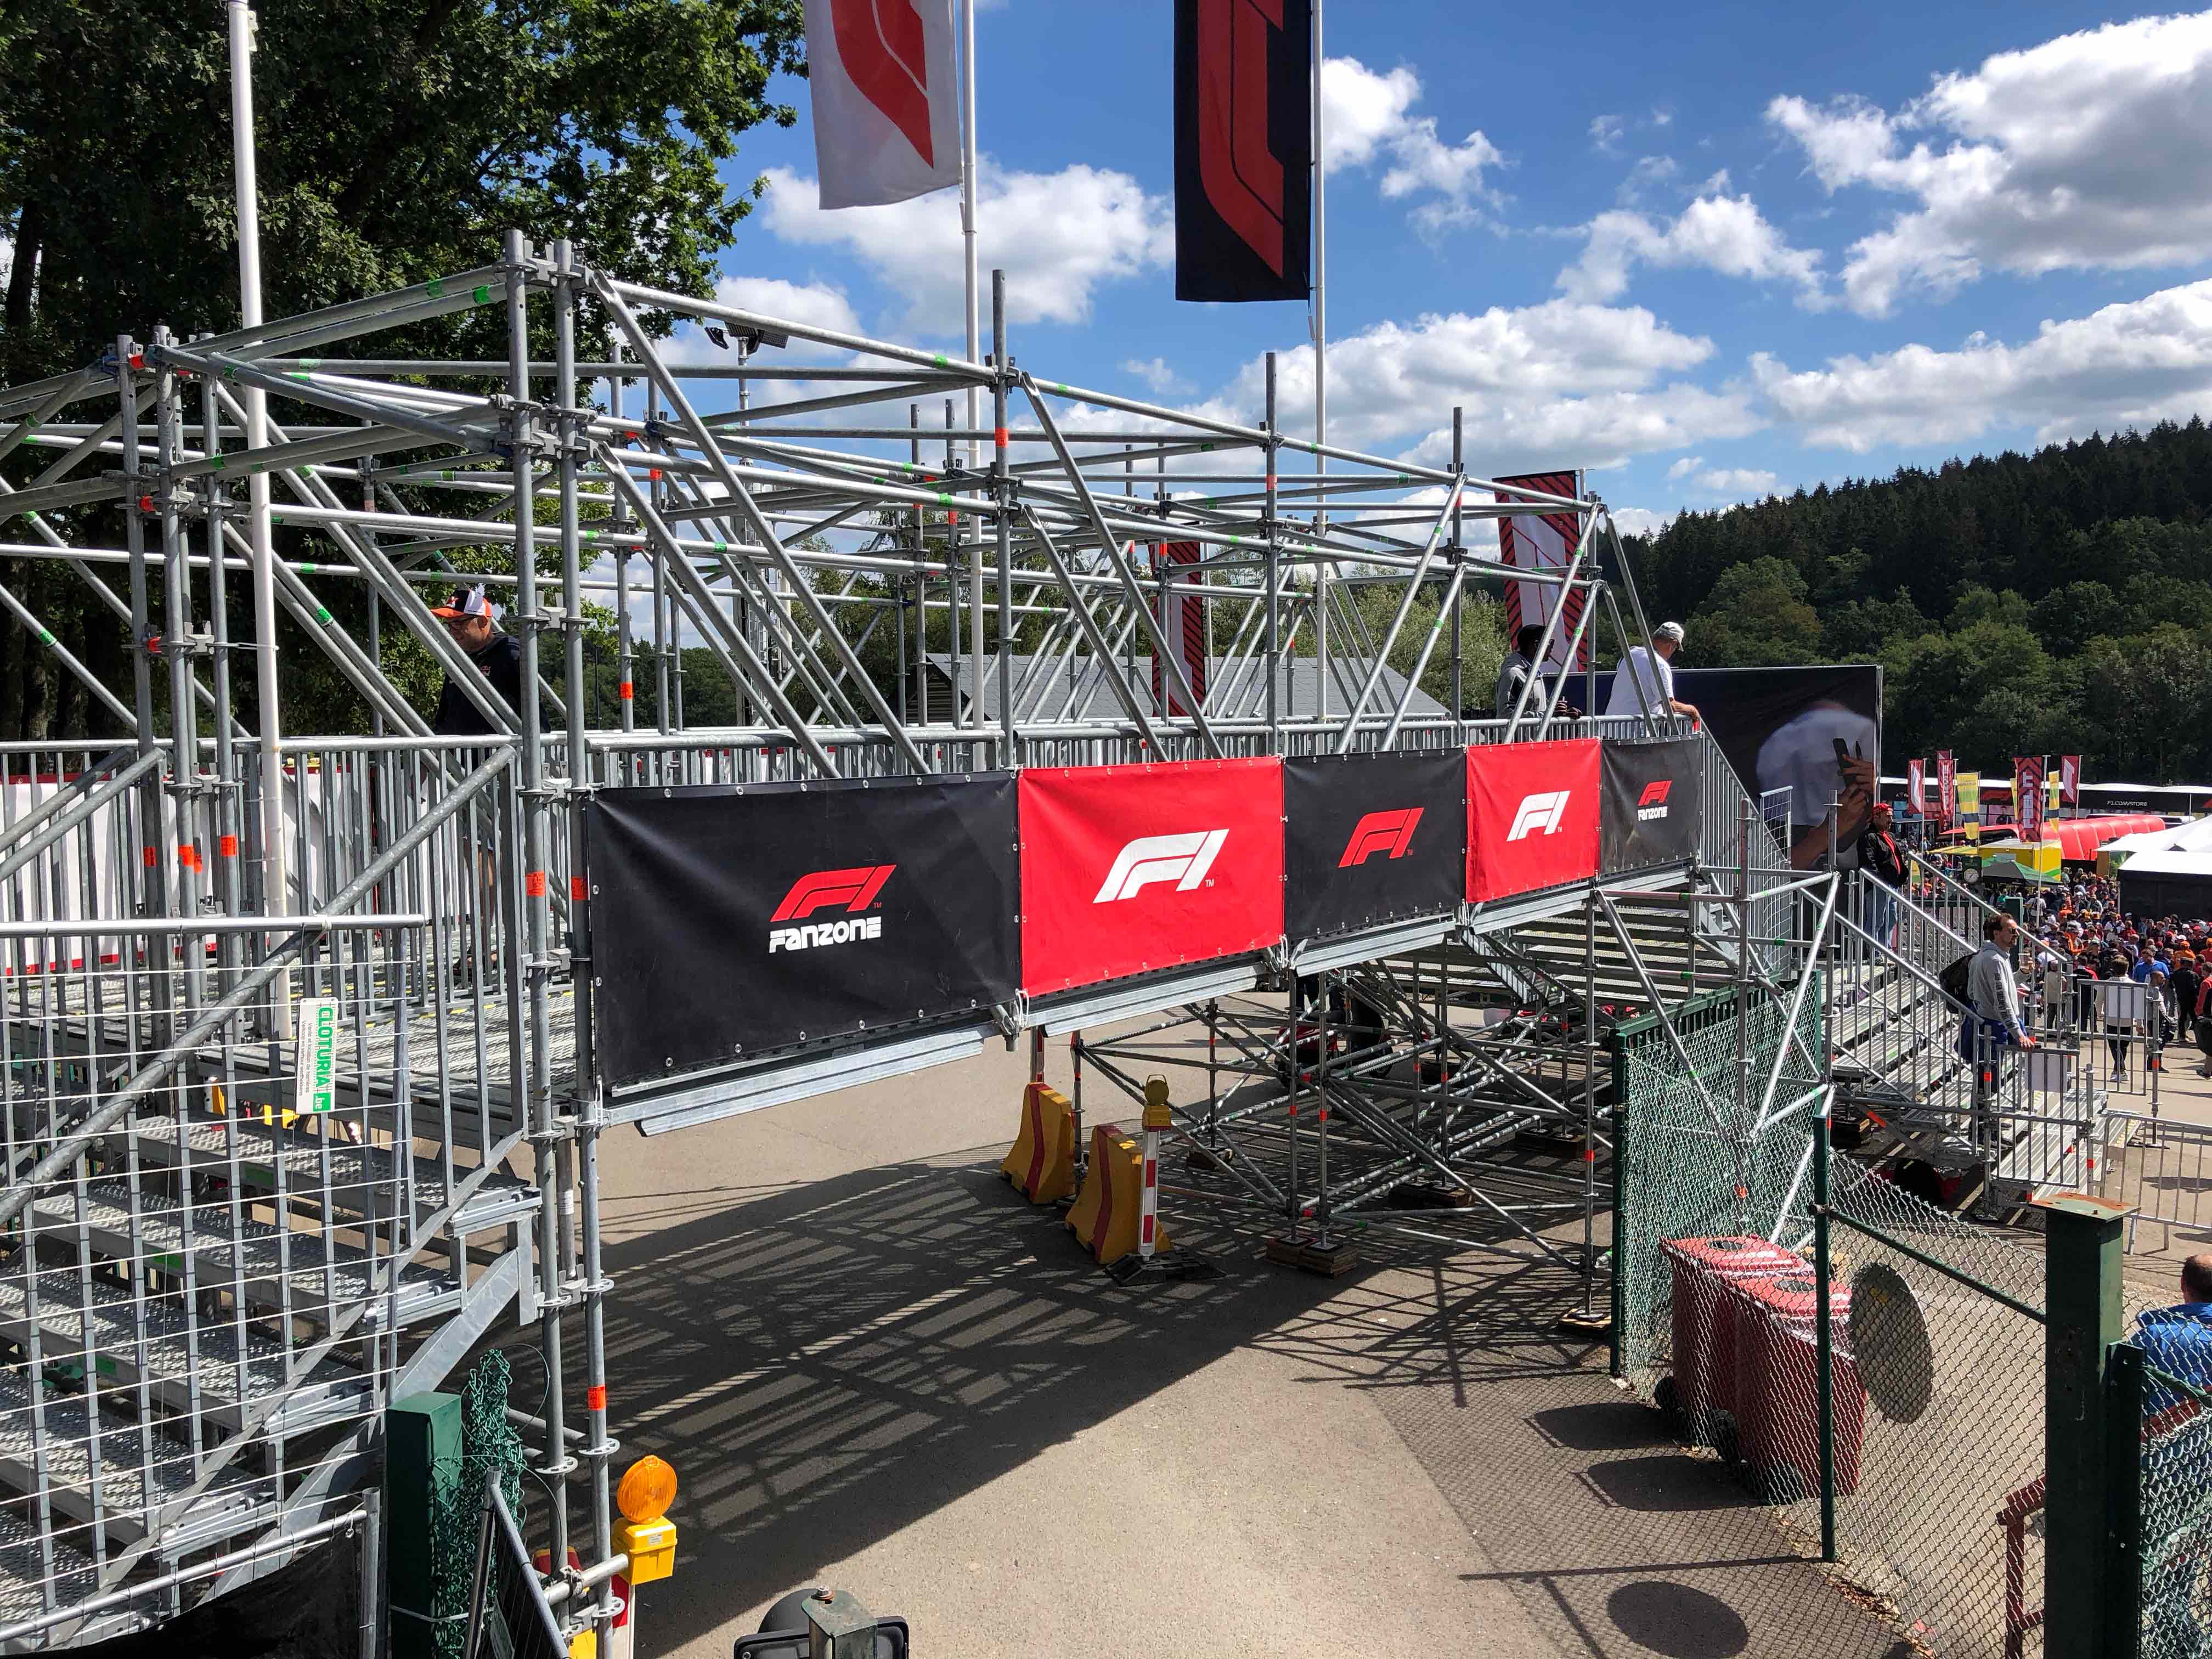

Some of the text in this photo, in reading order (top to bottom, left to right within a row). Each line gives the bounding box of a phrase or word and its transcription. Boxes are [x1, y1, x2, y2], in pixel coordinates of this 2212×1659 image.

[1506, 790, 1571, 842] F1
[1638, 780, 1673, 806] F1
[2023, 772, 2034, 828] FEEL IT
[1093, 828, 1229, 904] F1
[1338, 807, 1425, 868] F1
[769, 864, 897, 923] F1
